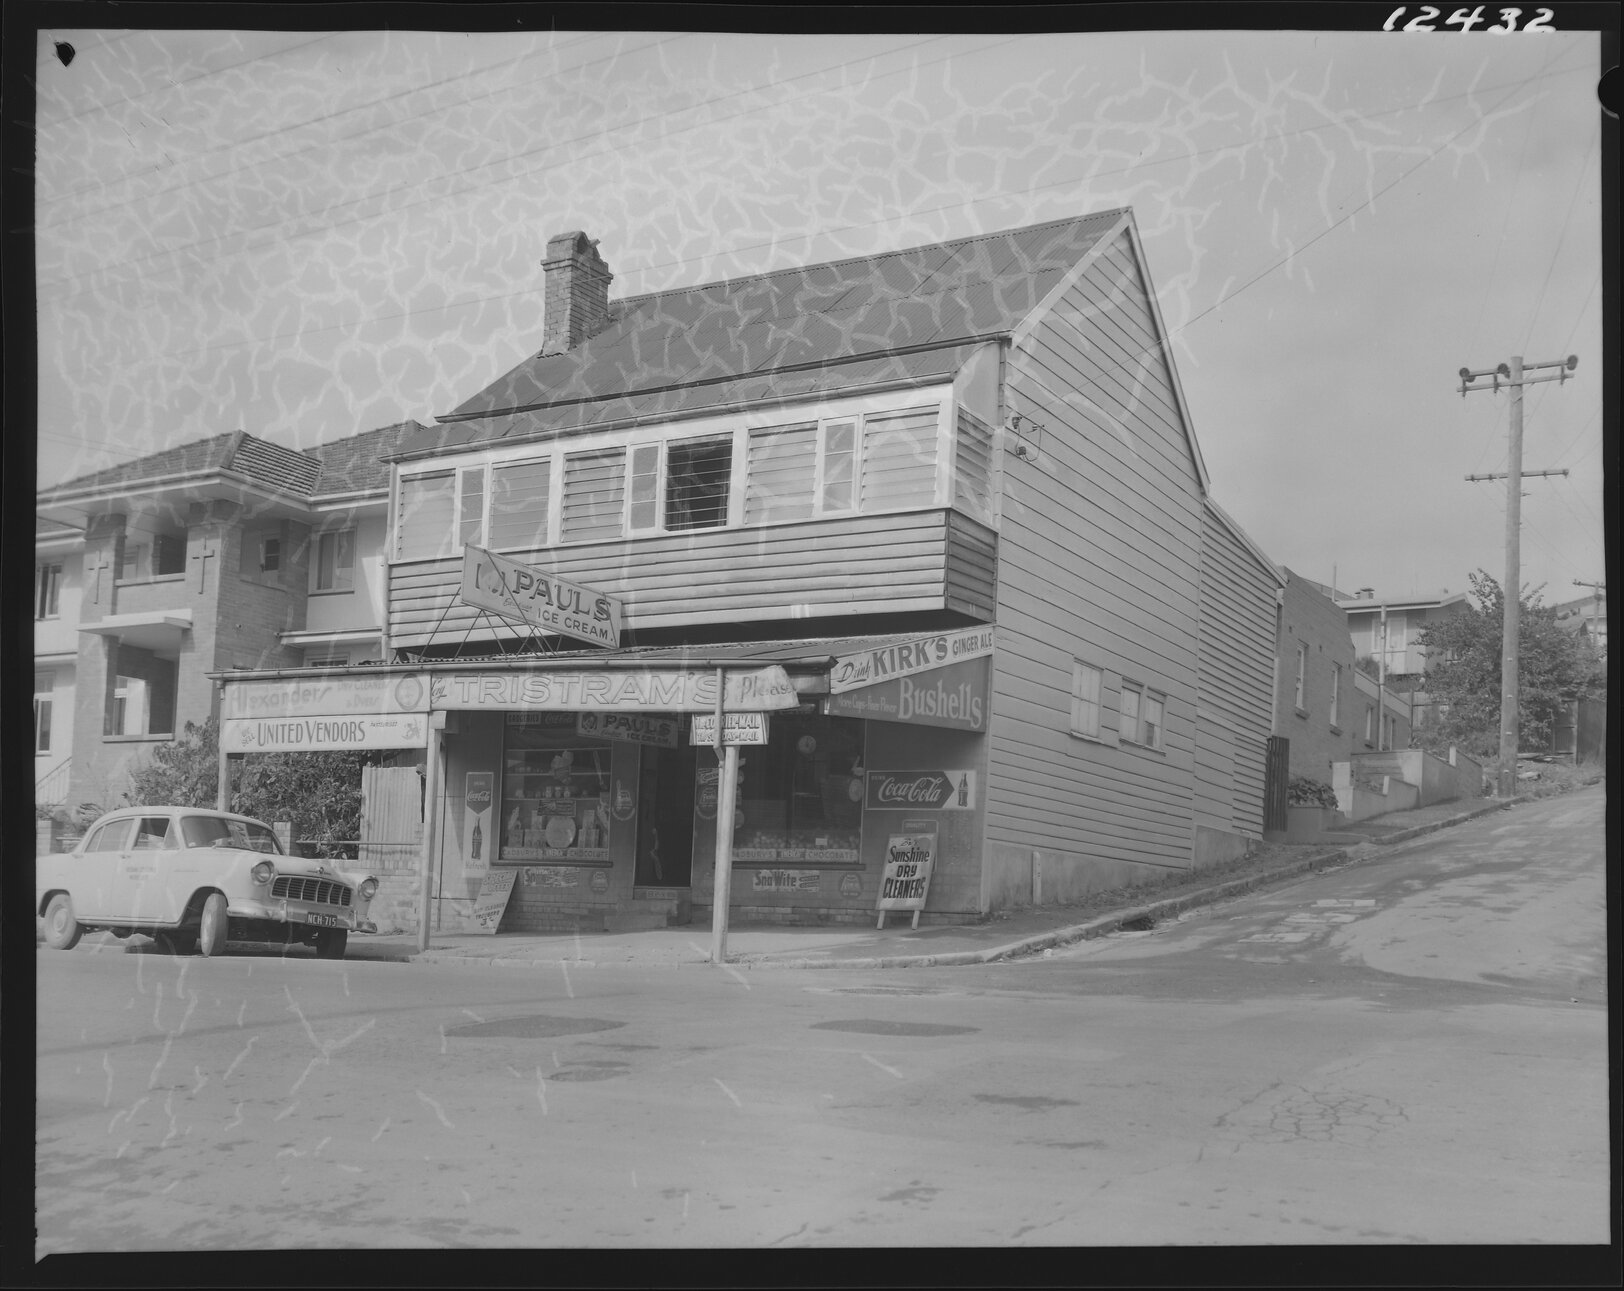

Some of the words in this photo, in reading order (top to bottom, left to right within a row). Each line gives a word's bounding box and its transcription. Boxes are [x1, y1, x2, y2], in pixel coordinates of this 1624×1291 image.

[1382, 5, 1557, 36] 12432
[512, 569, 612, 623] PAULS
[538, 608, 559, 624] ICE
[837, 659, 872, 685] Drink
[872, 637, 949, 678] KIRK'S
[952, 636, 979, 656] GINGER
[980, 632, 993, 650] ALE
[455, 673, 730, 706] TRISTRAM'S
[741, 675, 798, 703] Please
[898, 678, 983, 729] Bushells
[258, 722, 304, 747] UNITED
[305, 720, 367, 745] VENDORS
[603, 714, 672, 737] PAULS
[467, 790, 491, 802] Coca-Cola
[878, 777, 945, 803] Coca-Cola
[888, 845, 930, 864] Sunshine
[896, 865, 918, 878] DRY
[882, 876, 926, 899] CLEANERS
[307, 913, 337, 927] NCH-715
